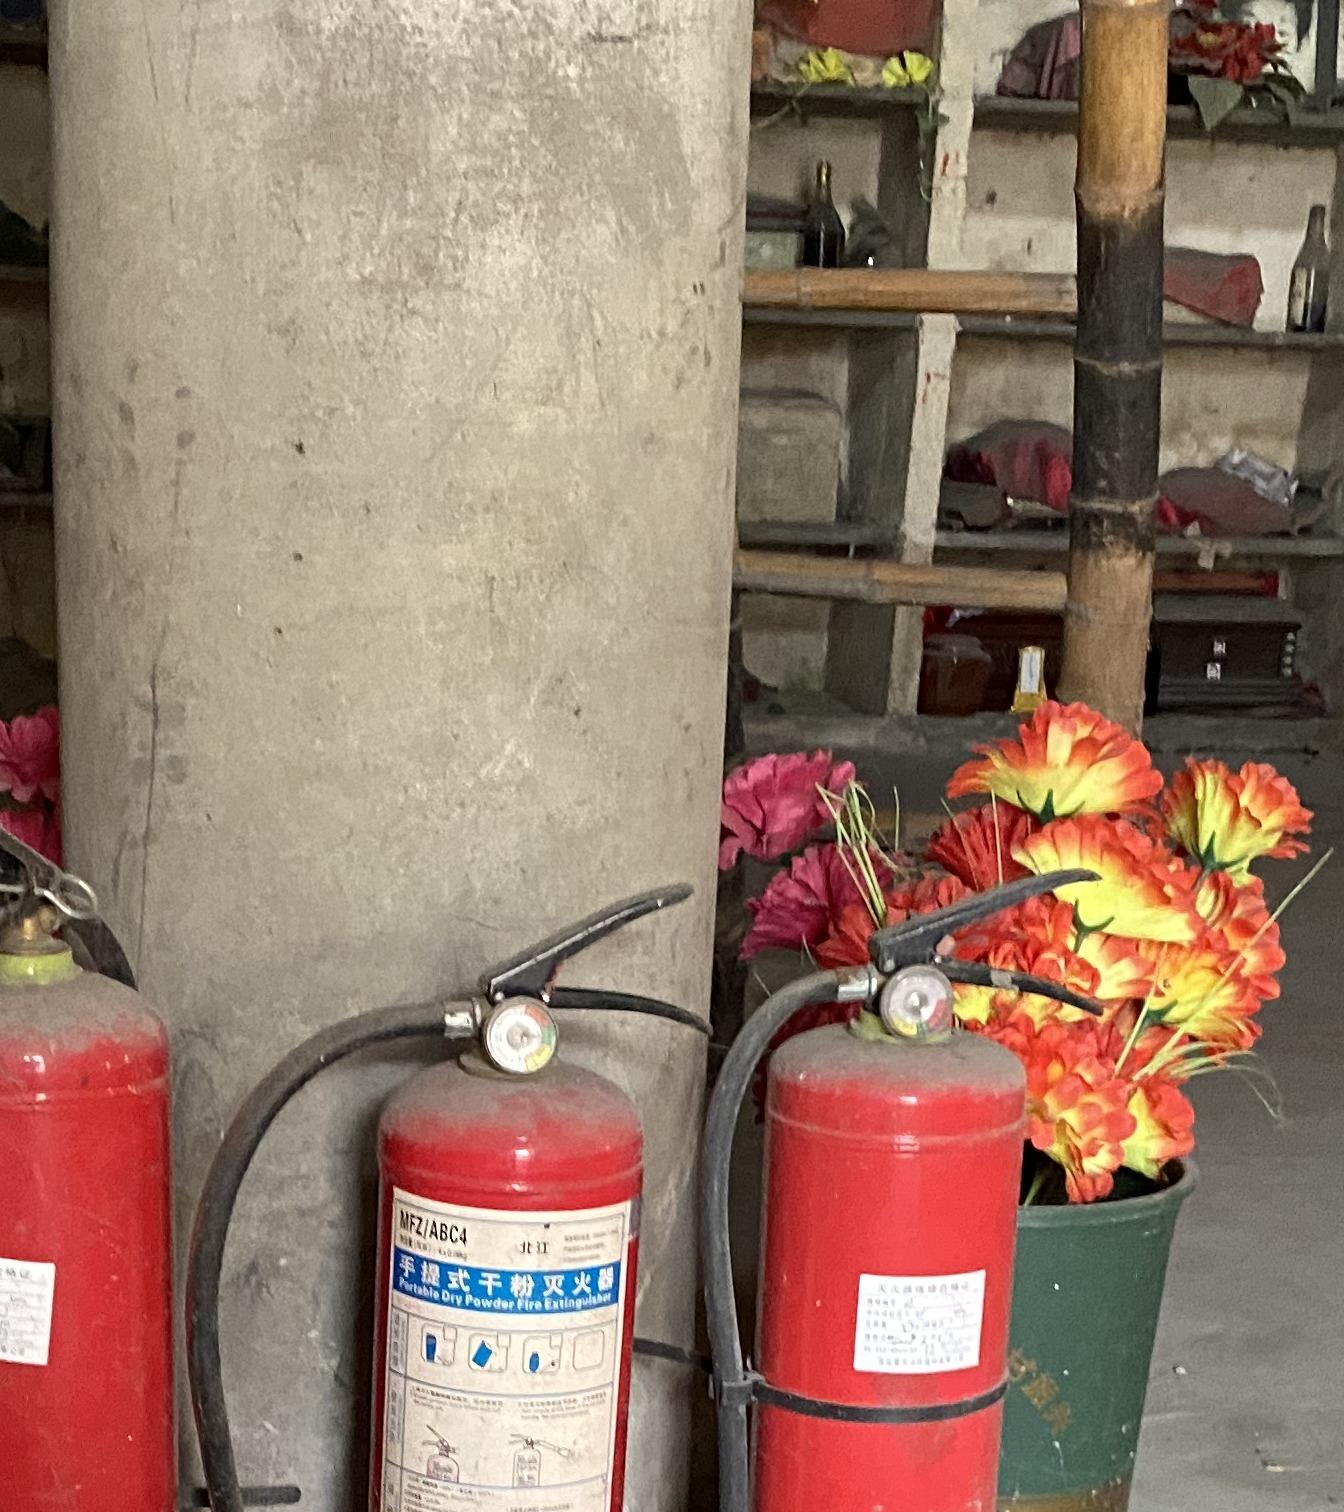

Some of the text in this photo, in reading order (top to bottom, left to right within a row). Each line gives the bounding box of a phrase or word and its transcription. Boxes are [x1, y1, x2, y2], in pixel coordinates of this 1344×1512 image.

[399, 1209, 467, 1246] MFZ/ABC4
[399, 1275, 440, 1300] Portable
[442, 1288, 463, 1306] Dry
[465, 1293, 515, 1311] Powder
[517, 1298, 543, 1311] Fire
